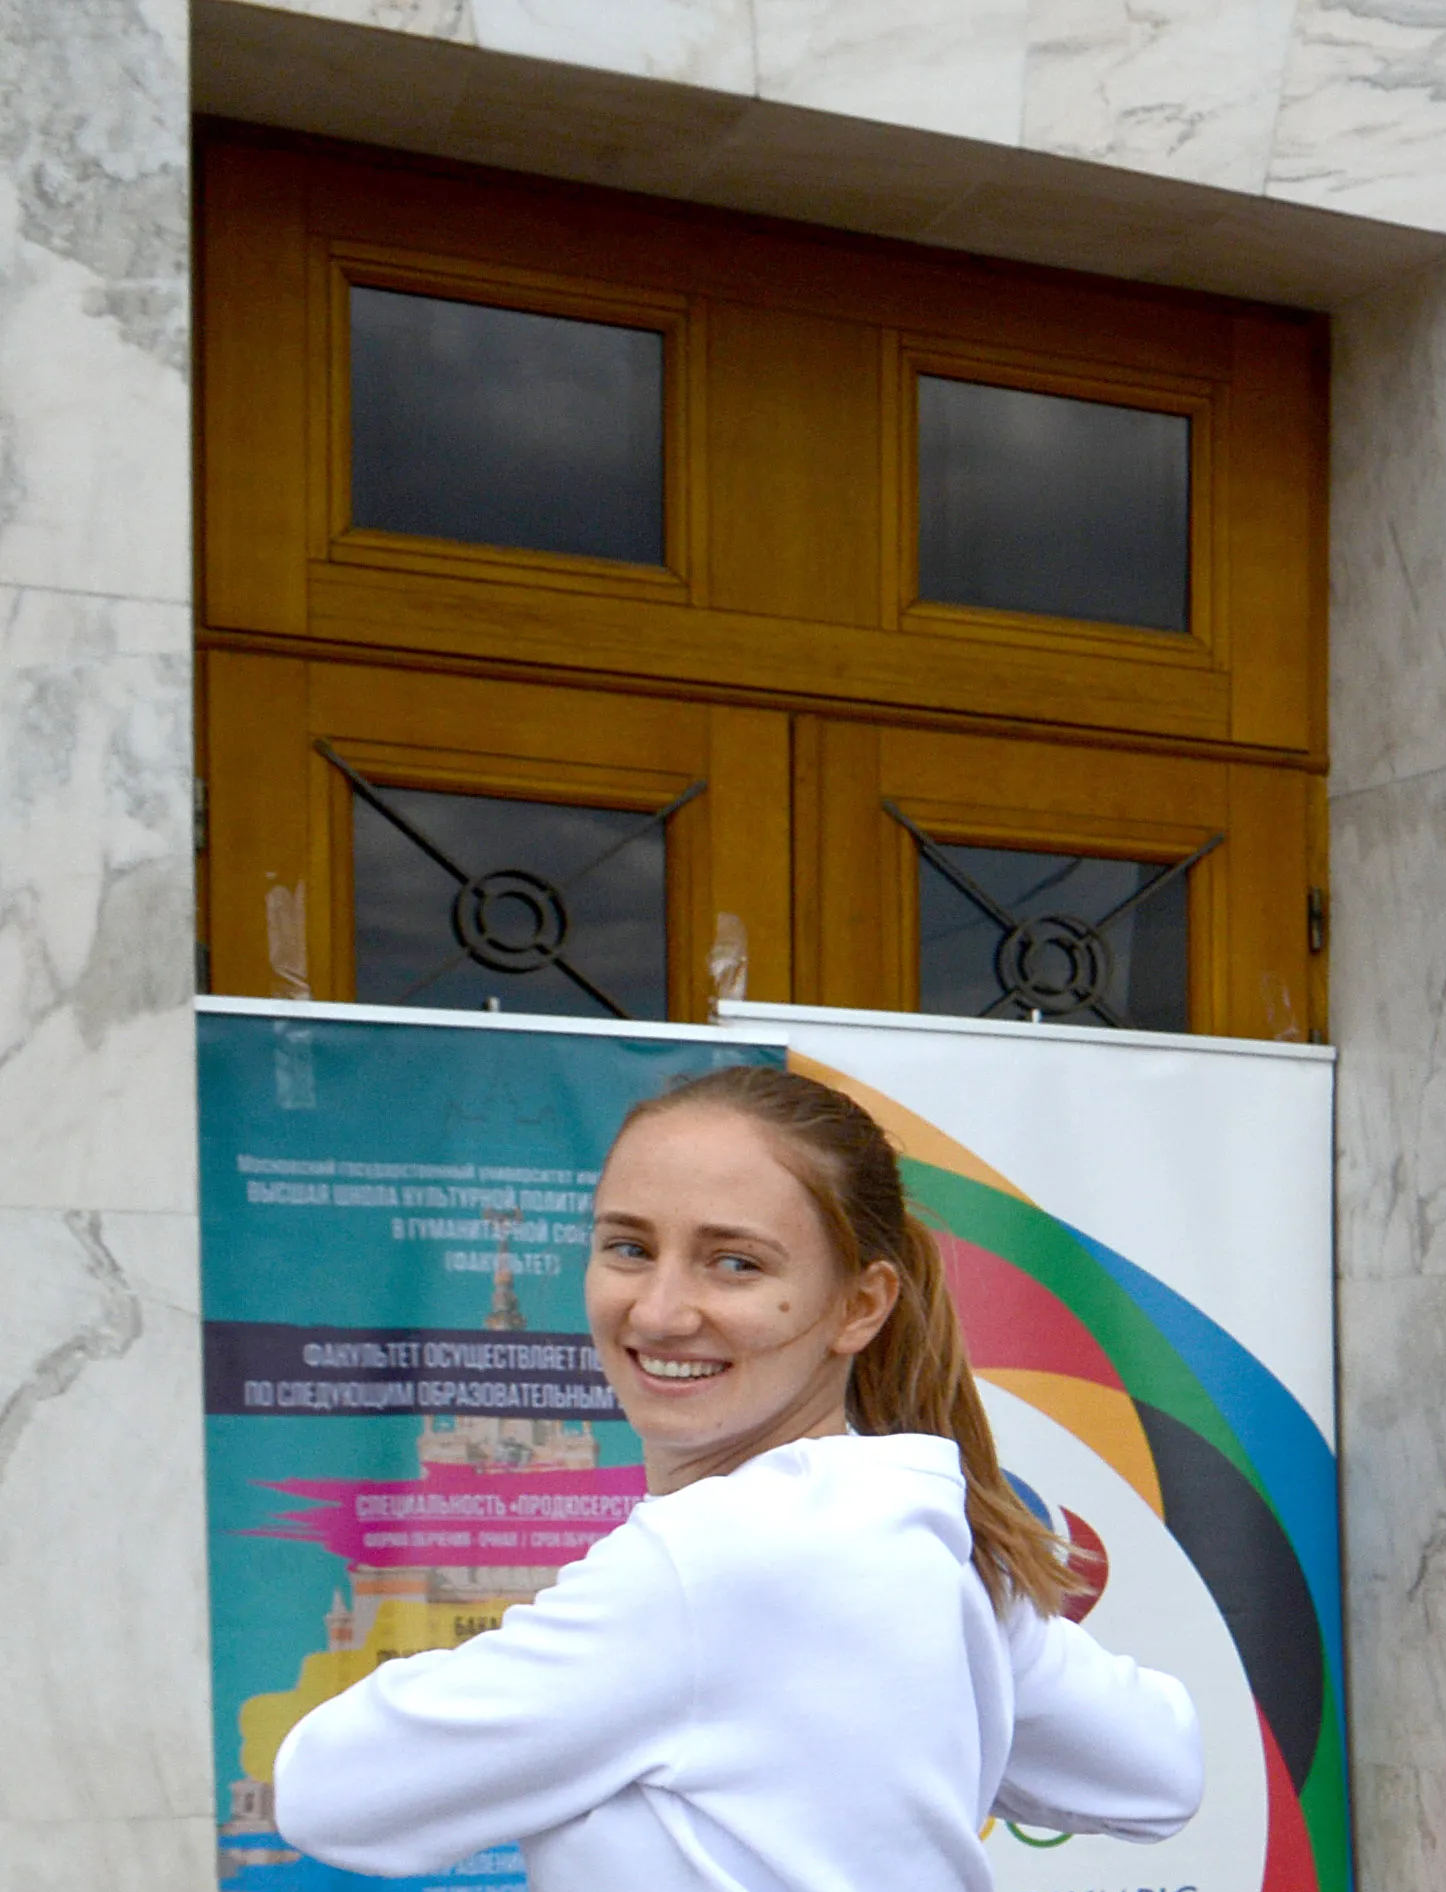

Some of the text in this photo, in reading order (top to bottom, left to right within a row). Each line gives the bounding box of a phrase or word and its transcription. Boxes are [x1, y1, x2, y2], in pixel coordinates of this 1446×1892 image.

[423, 1342, 576, 1371] ОСУЩЕСТВЛЯЕТ
[244, 1381, 273, 1406] ПО
[418, 1381, 614, 1409] ОБРАЗОВАТЕЛЬНЫМ
